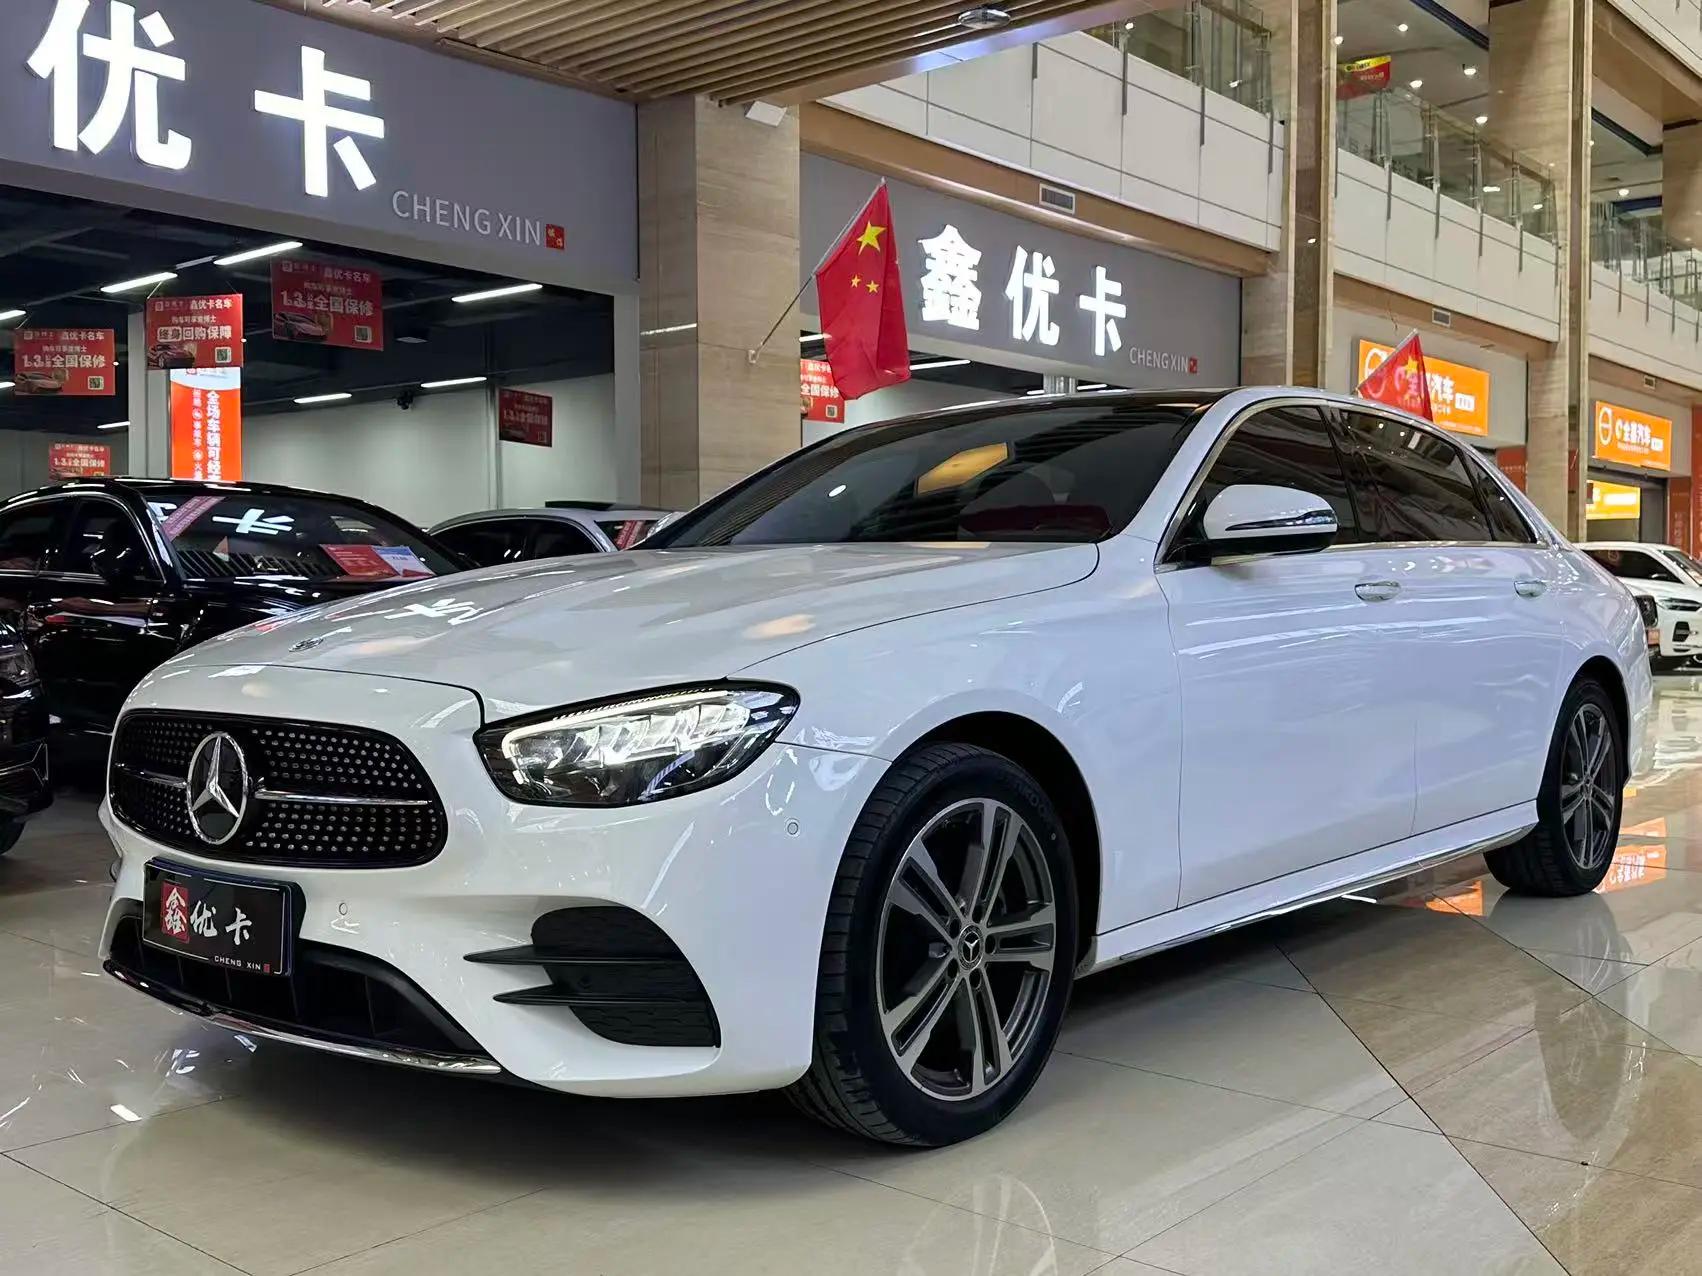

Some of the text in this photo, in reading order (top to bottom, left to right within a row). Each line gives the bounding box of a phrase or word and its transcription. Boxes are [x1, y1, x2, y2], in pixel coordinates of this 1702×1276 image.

[27, 0, 384, 197] 优卡
[393, 190, 490, 235] CHENG
[499, 213, 540, 246] XIN
[918, 224, 1127, 356] 鑫优卡
[157, 325, 232, 342] 终身回购保障
[1129, 346, 1169, 369] CHENG
[1170, 353, 1189, 373] XIN
[165, 887, 253, 946] 鑫优卡
[214, 955, 242, 967] CHENG
[246, 961, 261, 971] XIN
